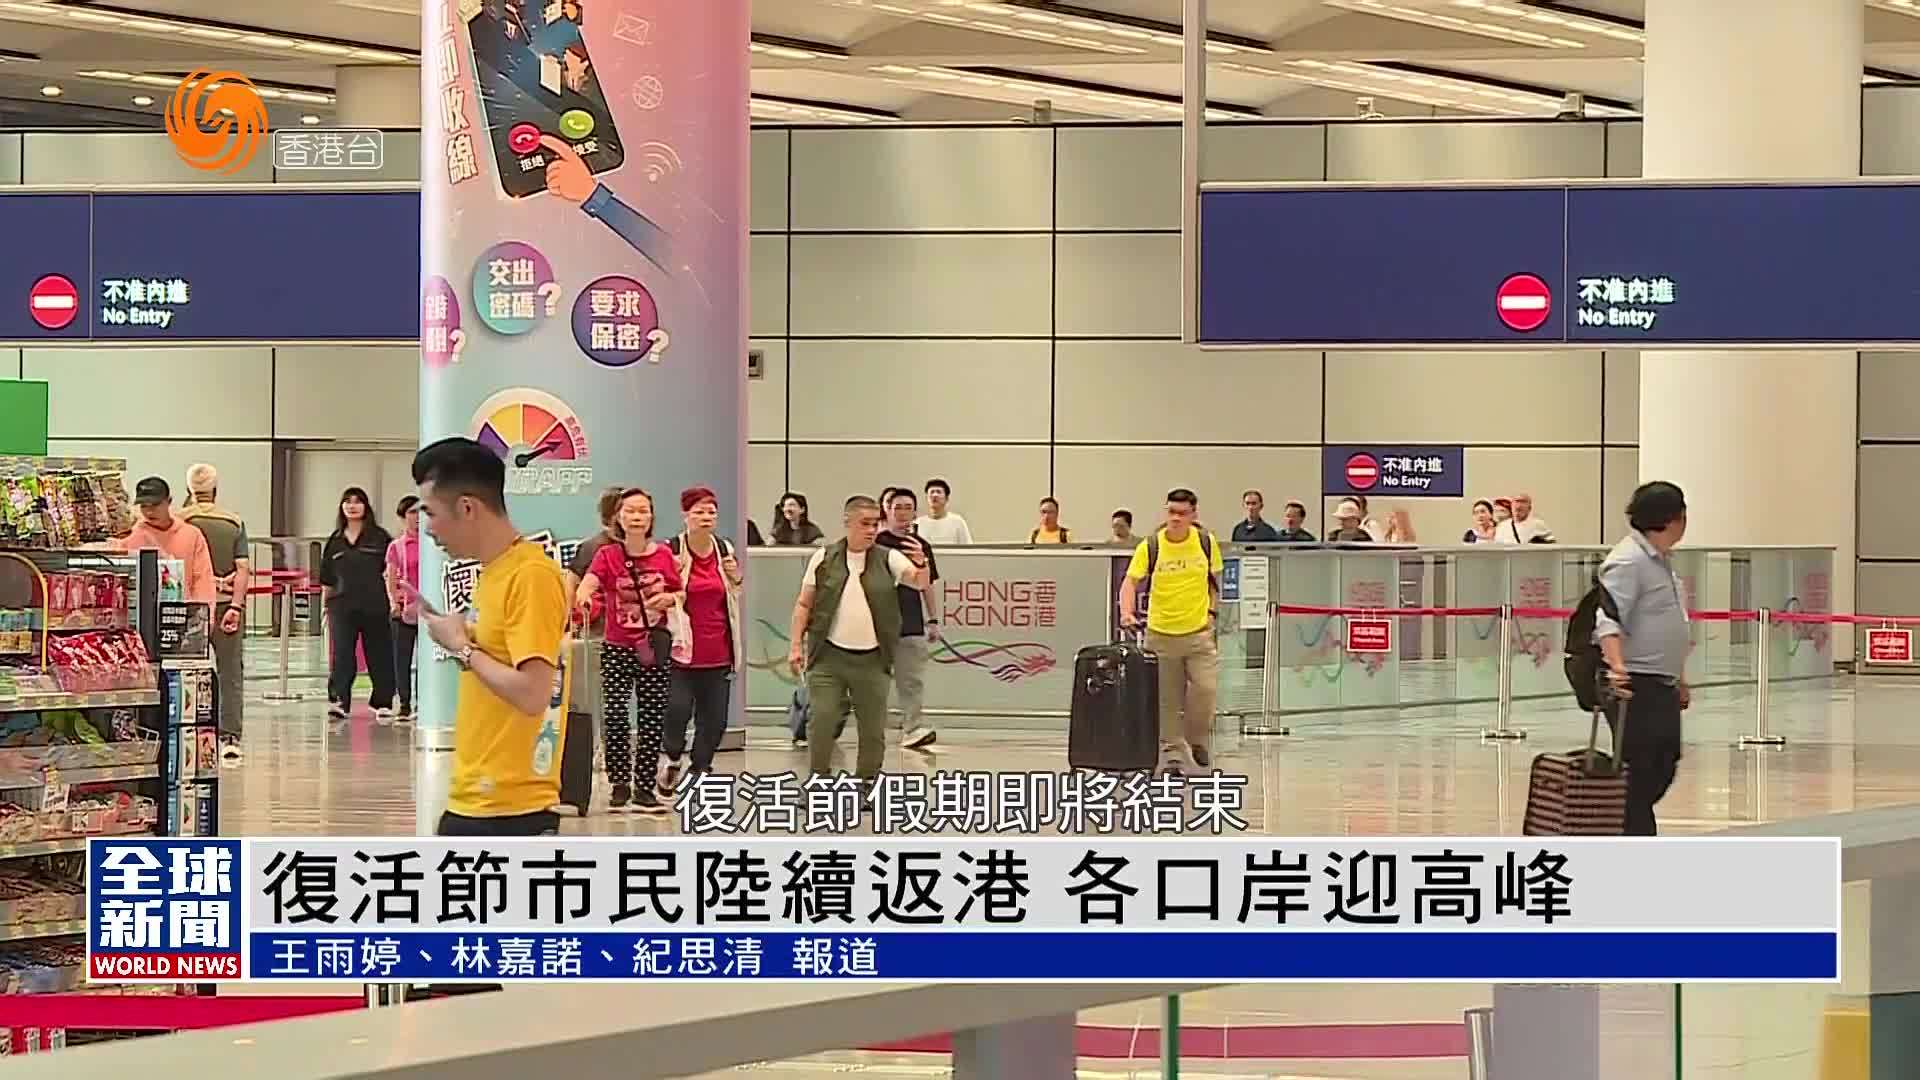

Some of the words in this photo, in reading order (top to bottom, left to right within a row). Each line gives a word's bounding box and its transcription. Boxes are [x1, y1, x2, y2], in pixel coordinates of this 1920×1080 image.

[489, 258, 535, 286] 交出
[103, 279, 191, 304] 不准內進
[1579, 277, 1674, 304] 不准內進
[489, 292, 535, 319] 密碼
[591, 289, 641, 316] 要求
[103, 307, 126, 325] No
[130, 307, 172, 329] Entry
[1578, 308, 1604, 326] No
[1609, 308, 1656, 330] Entry
[591, 323, 641, 350] 保密
[1383, 457, 1443, 472] 不准內進
[1383, 476, 1399, 486] No
[1401, 476, 1431, 488] Entry
[943, 580, 1031, 602] HONG
[943, 605, 1031, 626] KONG
